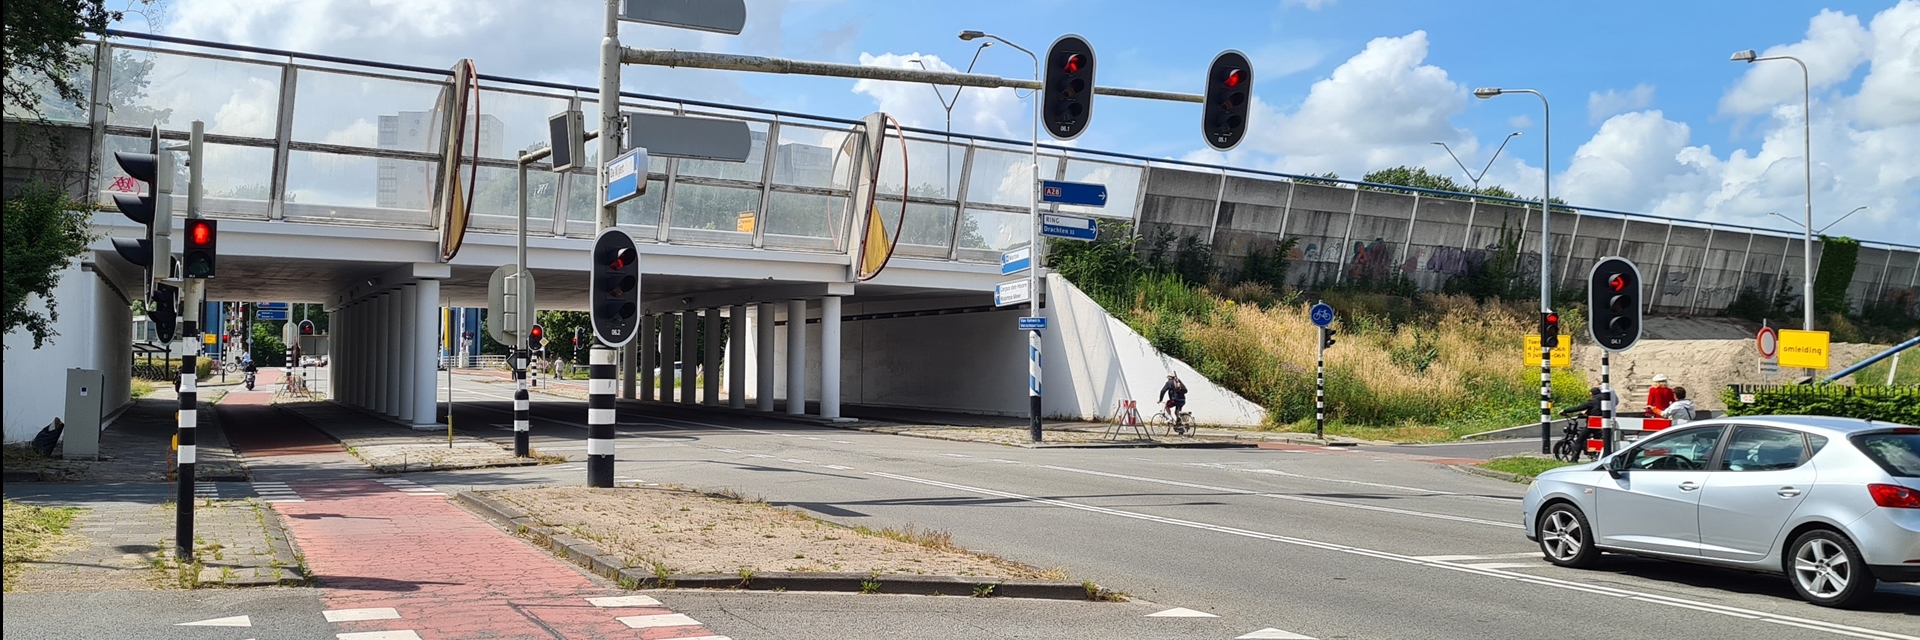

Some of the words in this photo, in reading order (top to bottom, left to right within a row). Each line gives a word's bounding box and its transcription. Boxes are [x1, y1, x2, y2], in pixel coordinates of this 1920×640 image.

[1045, 216, 1060, 224] RING
[1043, 225, 1069, 235] Drachten
[611, 328, 621, 336] 06.2
[1783, 345, 1822, 356] omleiding
